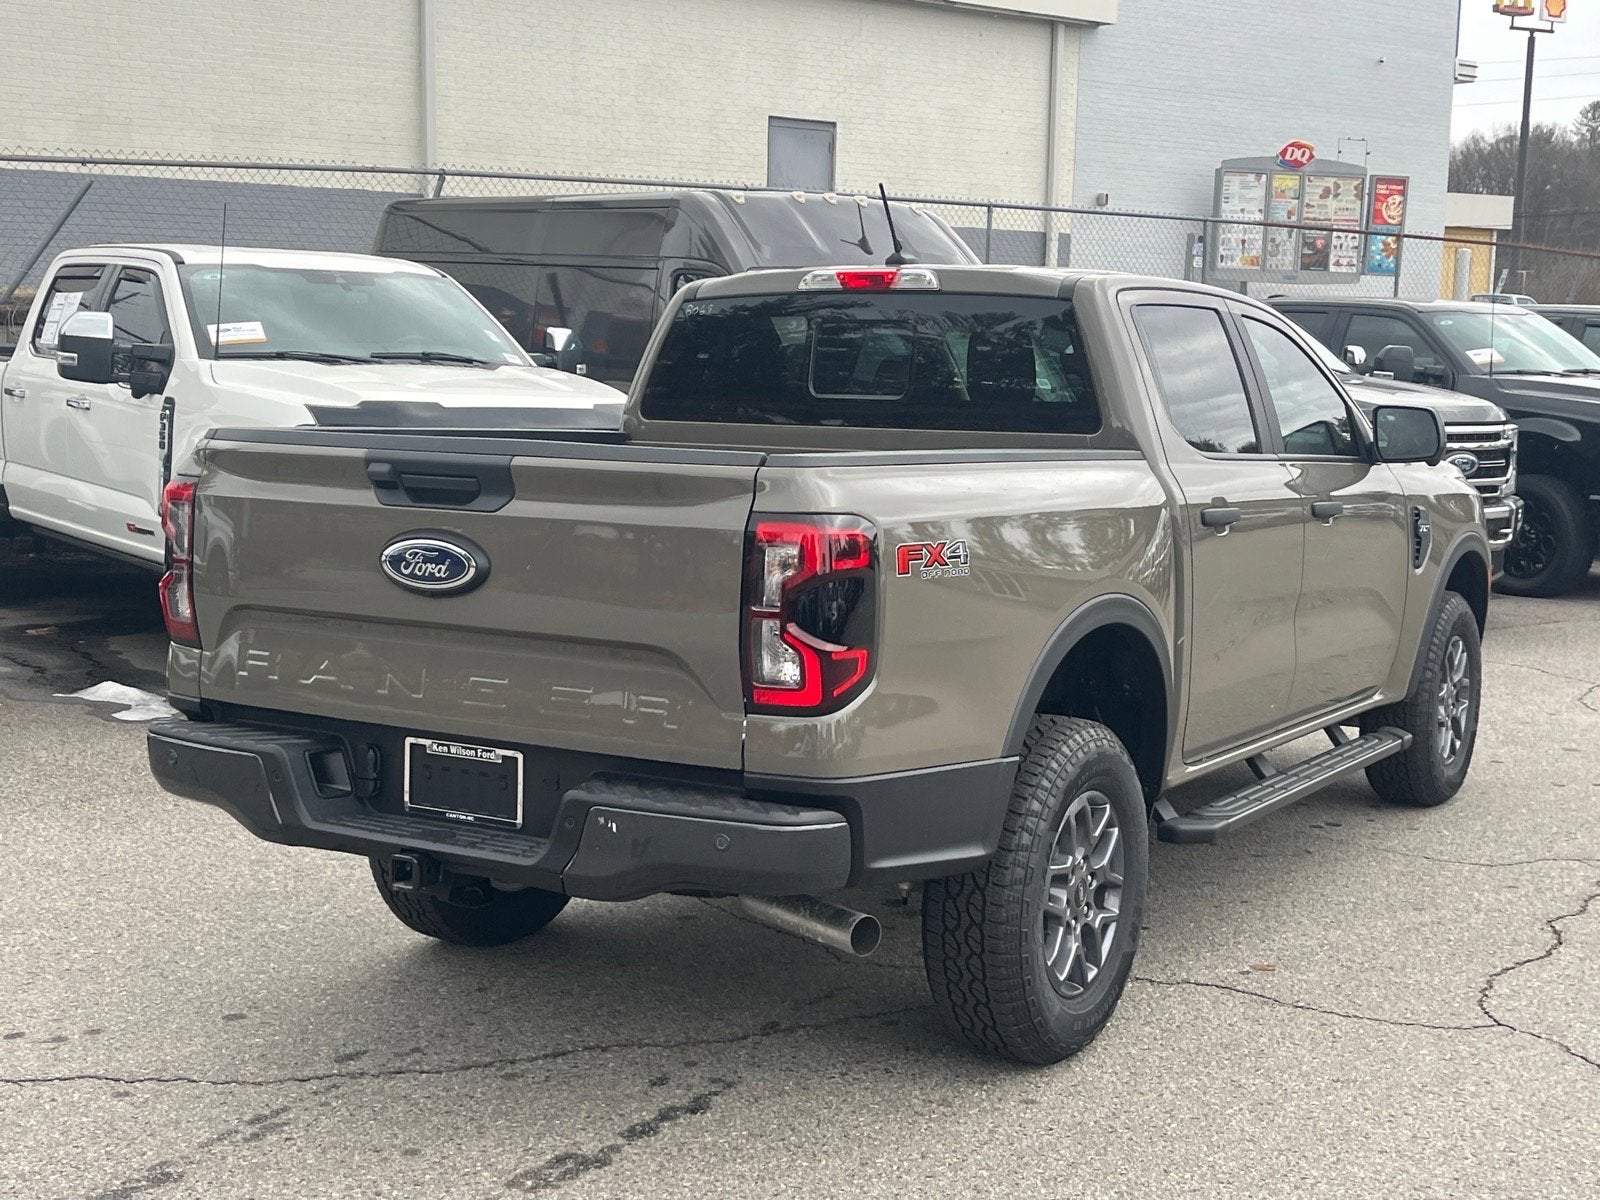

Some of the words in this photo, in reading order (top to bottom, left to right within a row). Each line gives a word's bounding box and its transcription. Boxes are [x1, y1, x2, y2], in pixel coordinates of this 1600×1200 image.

[1285, 146, 1311, 164] DQ
[400, 549, 451, 578] Ford
[896, 539, 969, 577] FX4
[921, 570, 942, 580] OFF
[944, 566, 970, 577] ROAD
[236, 644, 685, 729] RANGER
[432, 743, 448, 753] Ken
[450, 746, 476, 757] Wilson
[477, 749, 495, 759] Ford
